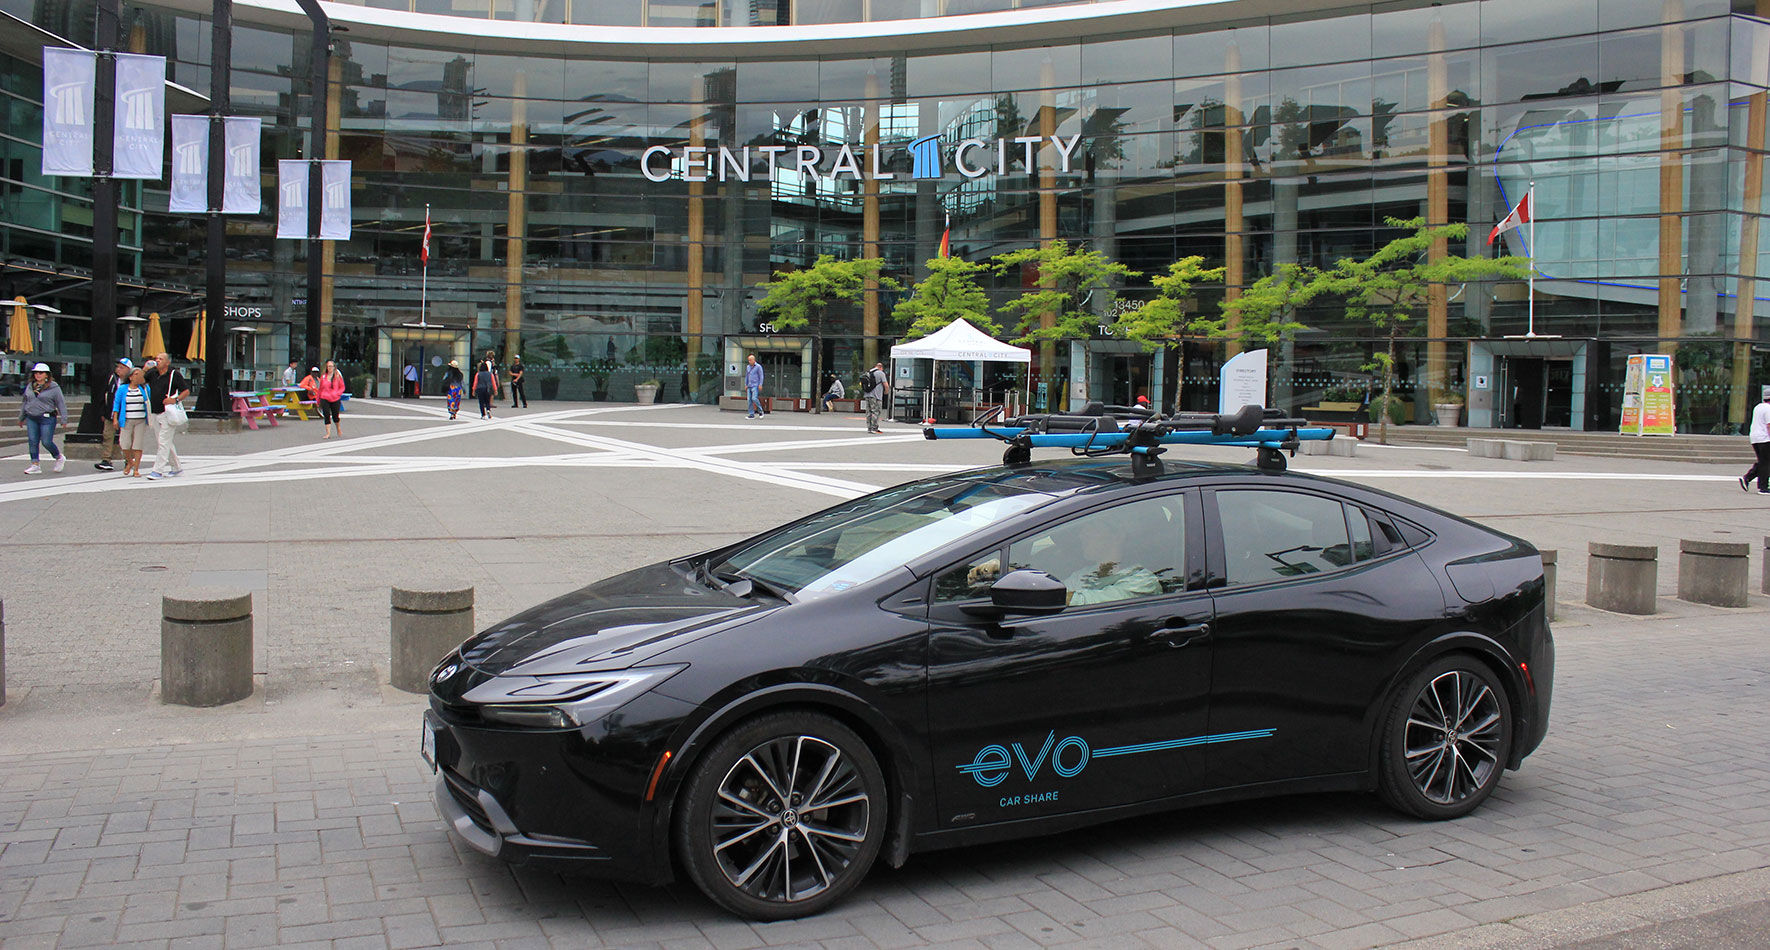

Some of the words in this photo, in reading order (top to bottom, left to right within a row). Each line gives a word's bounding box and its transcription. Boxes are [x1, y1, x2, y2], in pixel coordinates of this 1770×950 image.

[640, 144, 894, 183] CENTRAL
[954, 134, 1083, 179] CITY
[224, 306, 262, 318] SHOPS
[1114, 300, 1145, 310] 13450
[957, 351, 987, 359] CENTRAL
[956, 729, 1090, 787] evo
[1000, 795, 1021, 807] CAR
[1024, 791, 1059, 804] SHARE
